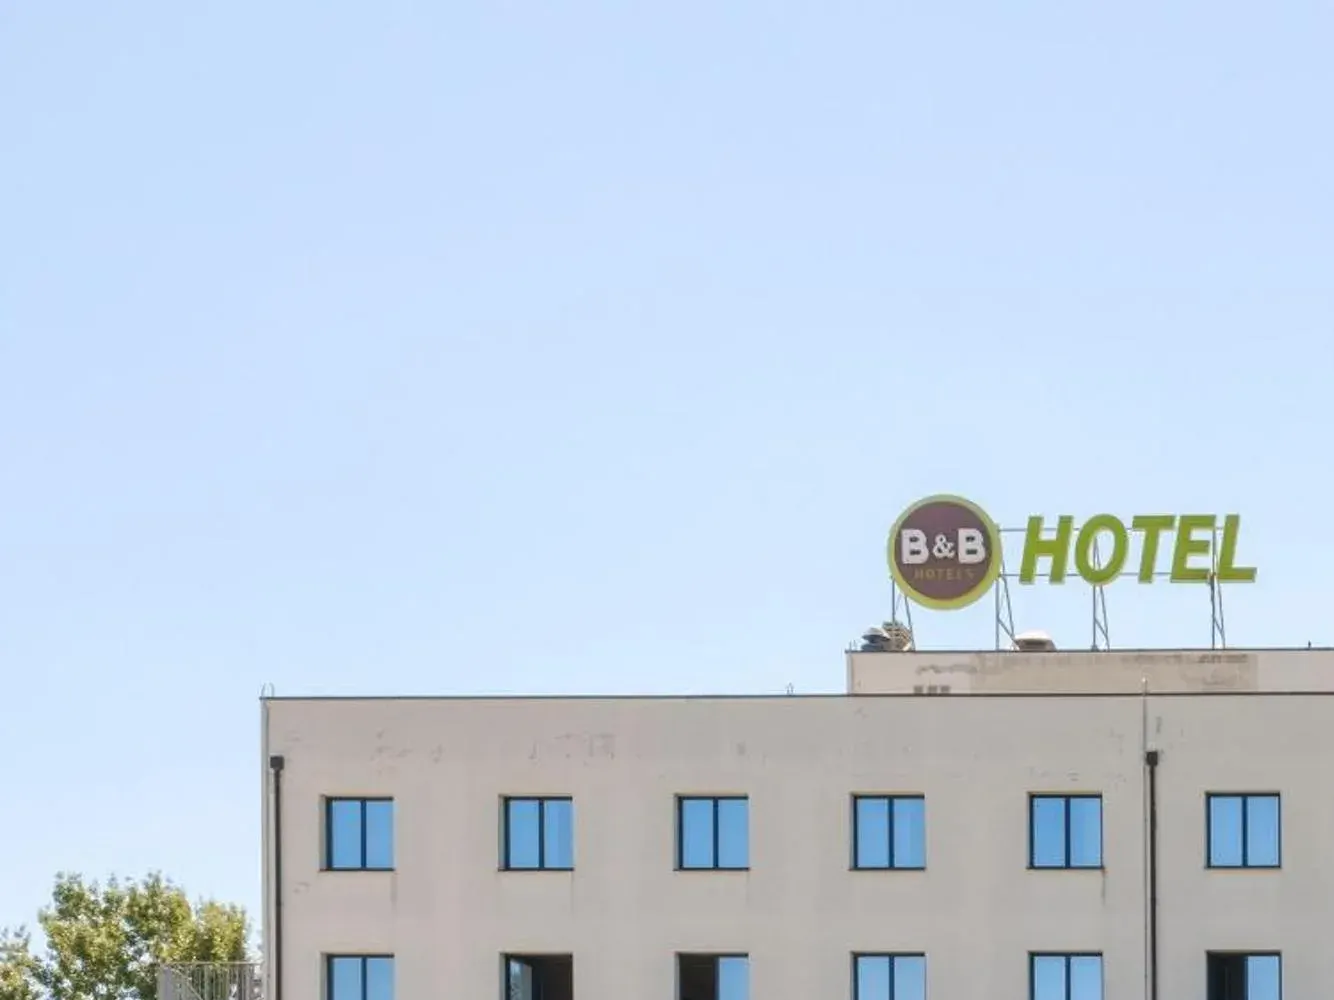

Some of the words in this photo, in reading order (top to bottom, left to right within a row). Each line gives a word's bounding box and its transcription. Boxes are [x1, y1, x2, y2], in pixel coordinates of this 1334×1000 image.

[901, 527, 985, 564] B&B
[1019, 513, 1257, 585] HOTEL
[913, 568, 976, 580] HOTELS
